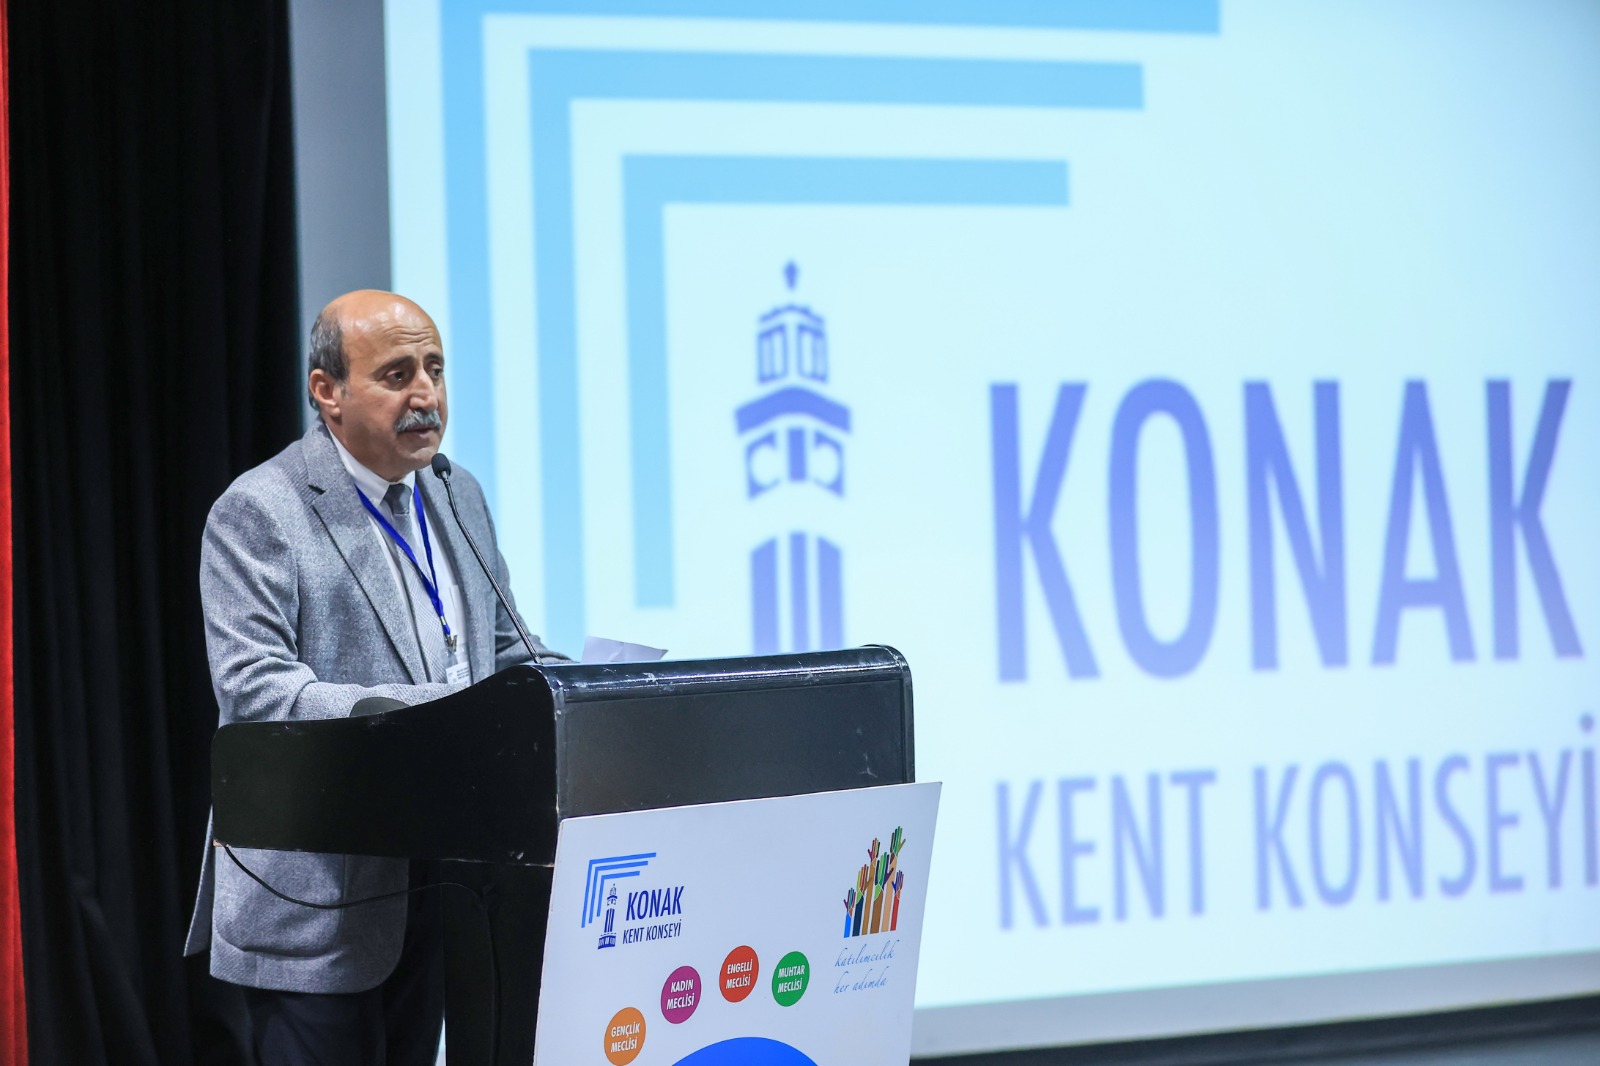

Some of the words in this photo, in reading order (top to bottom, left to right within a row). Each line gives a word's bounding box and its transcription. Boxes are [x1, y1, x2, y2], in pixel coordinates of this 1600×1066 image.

[989, 376, 1586, 684] KONAK
[996, 769, 1217, 932] KENT
[1253, 712, 1600, 912] KONSEYİ
[626, 886, 685, 921] KONAK
[623, 927, 645, 944] KENT
[646, 918, 682, 941] KONSEYİ
[727, 958, 753, 974] ENGELLİ
[778, 965, 806, 978] MUHTAR
[670, 979, 694, 993] KADIN
[725, 973, 751, 989] MECLİSİ
[777, 977, 803, 993] MECLİSİ
[833, 970, 849, 995] her
[666, 992, 695, 1010] MECLİSİ
[611, 1020, 641, 1038] GENÇLİK
[610, 1036, 638, 1053] MECLİSİ
